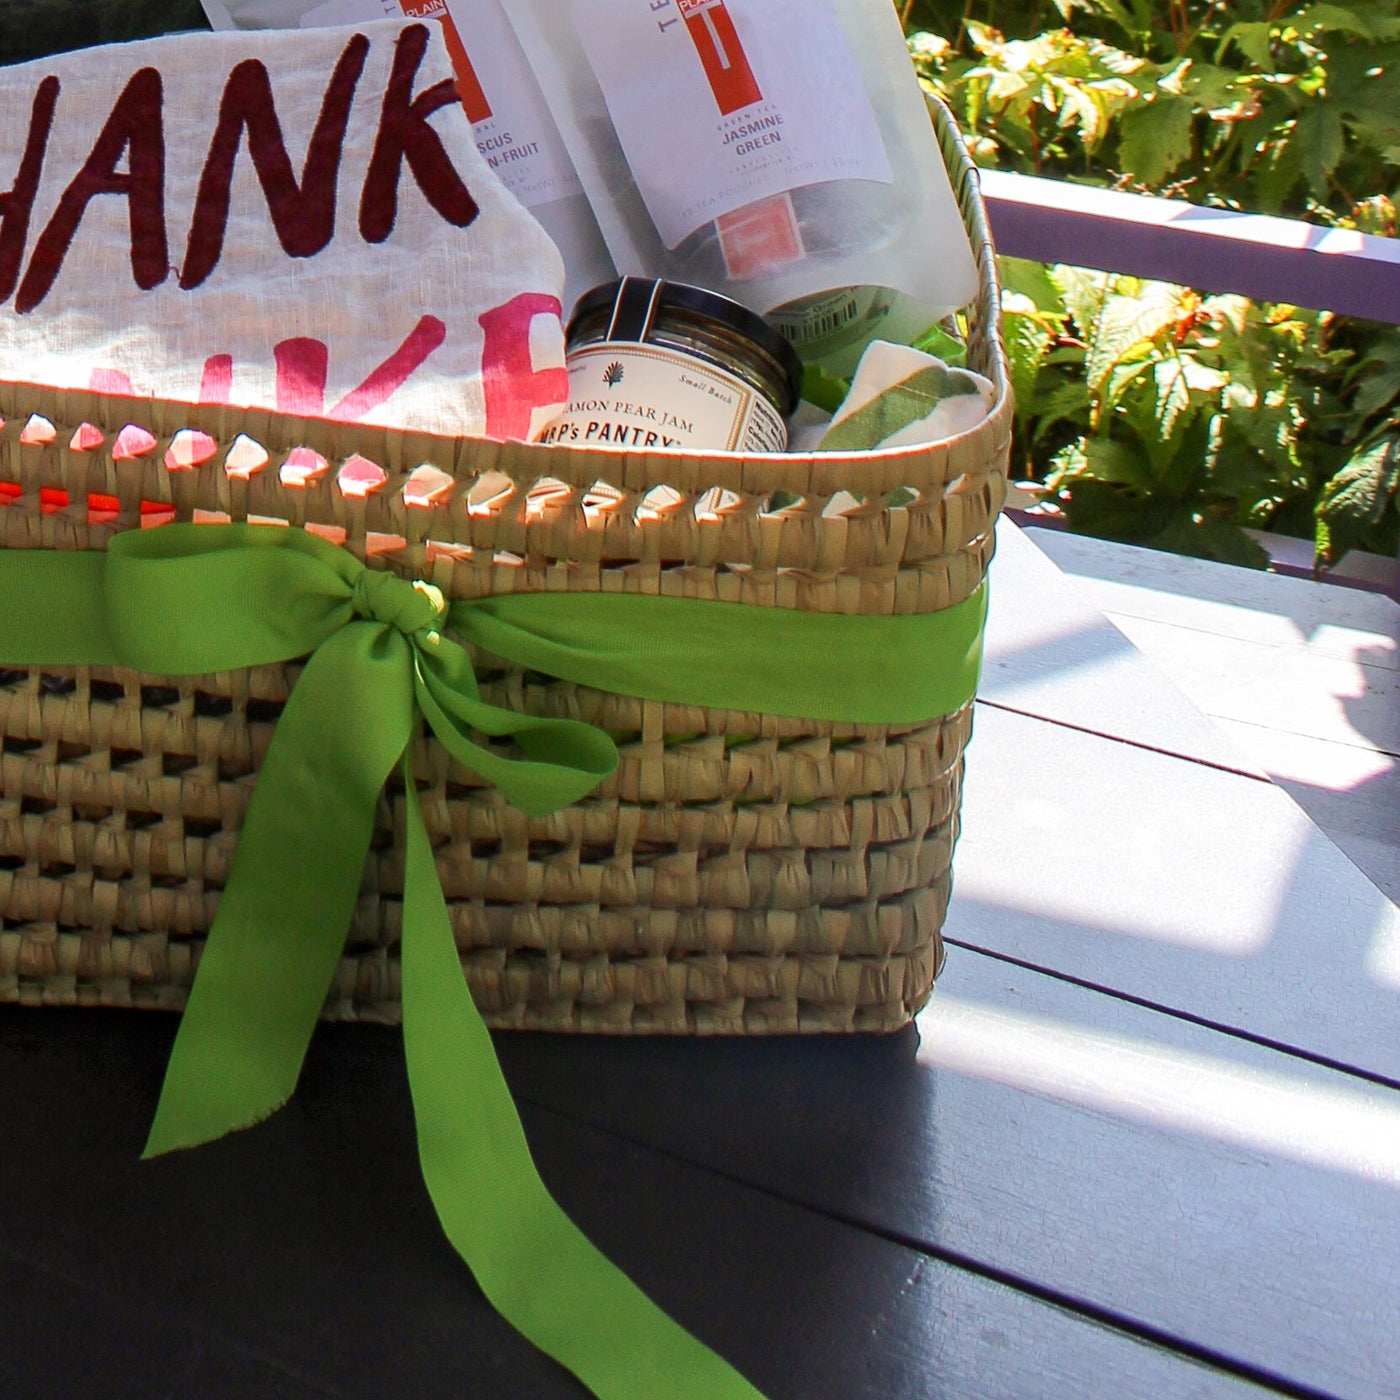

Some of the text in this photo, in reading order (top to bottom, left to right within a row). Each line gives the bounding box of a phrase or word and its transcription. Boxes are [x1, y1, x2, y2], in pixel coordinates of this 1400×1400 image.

[477, 132, 513, 154] SCUS
[722, 113, 785, 146] JASMINE
[736, 131, 782, 156] GREEN
[488, 141, 540, 169] N-FRUIT
[679, 373, 733, 404] Small Batch
[562, 399, 694, 433] AMON PEAR JAM
[585, 421, 675, 447] PANTRY
